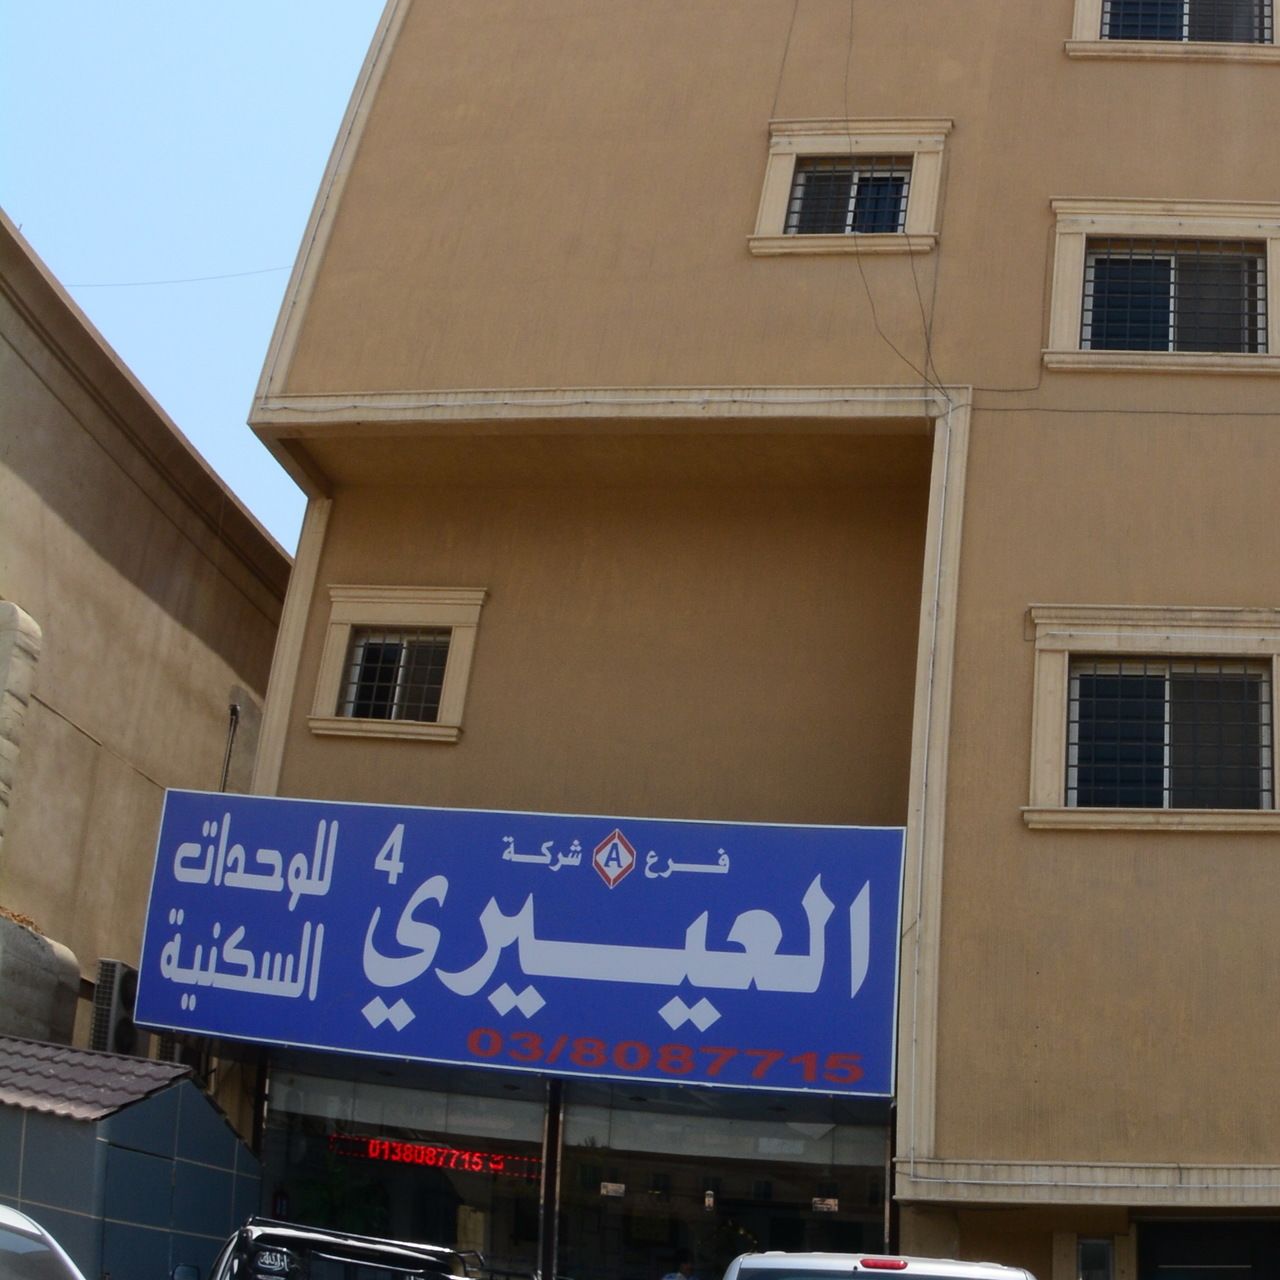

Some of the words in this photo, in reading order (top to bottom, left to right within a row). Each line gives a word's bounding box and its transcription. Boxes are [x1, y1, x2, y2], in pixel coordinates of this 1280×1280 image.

[174, 813, 338, 911] للوحدات
[375, 824, 404, 884] 4
[503, 836, 582, 871] شركة
[645, 848, 729, 878] فرع
[161, 909, 324, 1010] السكنية
[362, 874, 870, 1032] العييري
[469, 1029, 862, 1082] 03/8087715
[368, 1139, 482, 1170] 0138087715
